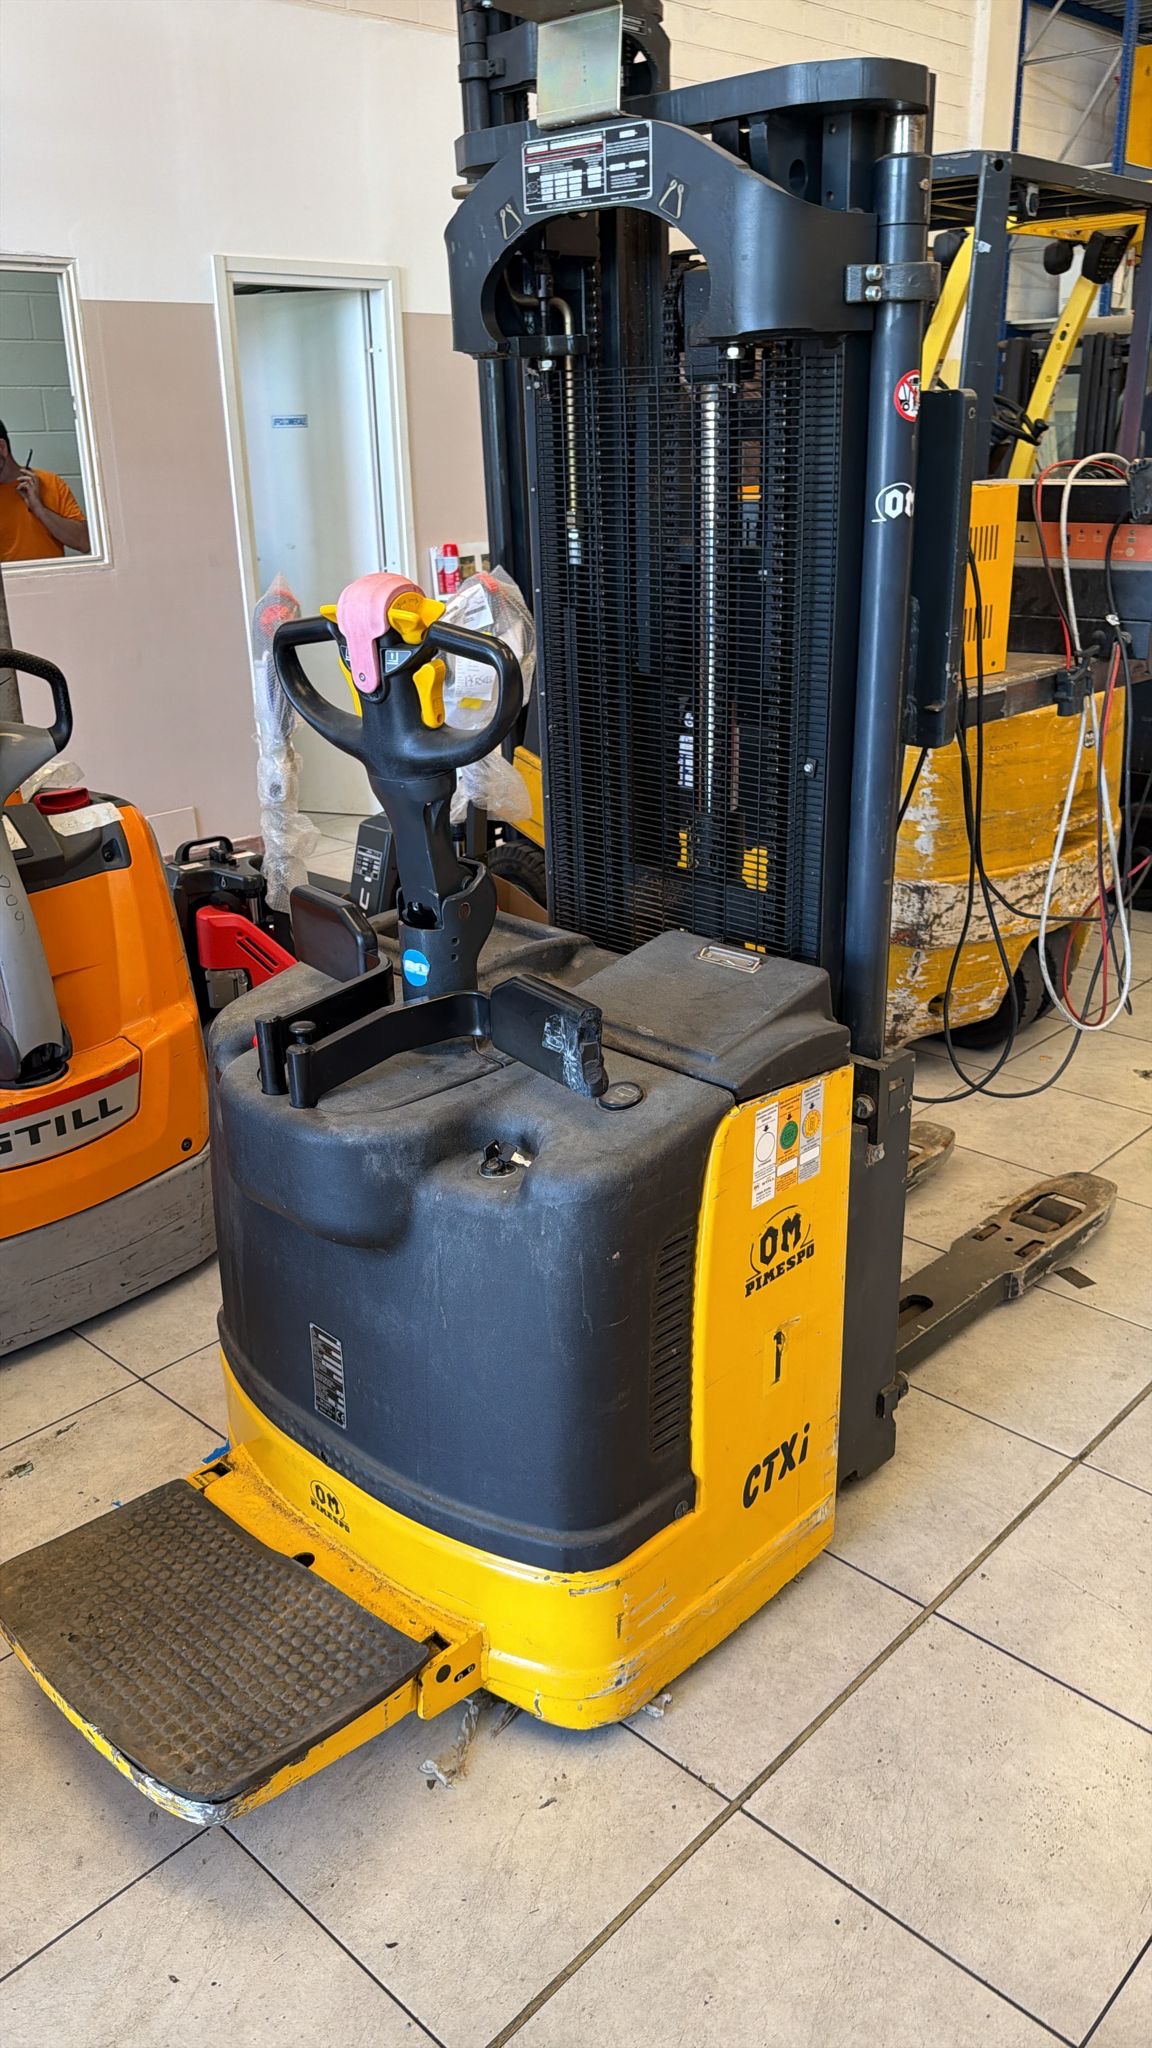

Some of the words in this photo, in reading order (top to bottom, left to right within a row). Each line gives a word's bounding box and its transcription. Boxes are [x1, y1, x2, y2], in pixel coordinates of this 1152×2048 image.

[760, 1212, 802, 1266] OM
[745, 1243, 815, 1298] PIMESPO
[743, 1422, 810, 1509] CTXi
[310, 1496, 350, 1533] PIMESPO
[315, 1484, 340, 1515] OM
